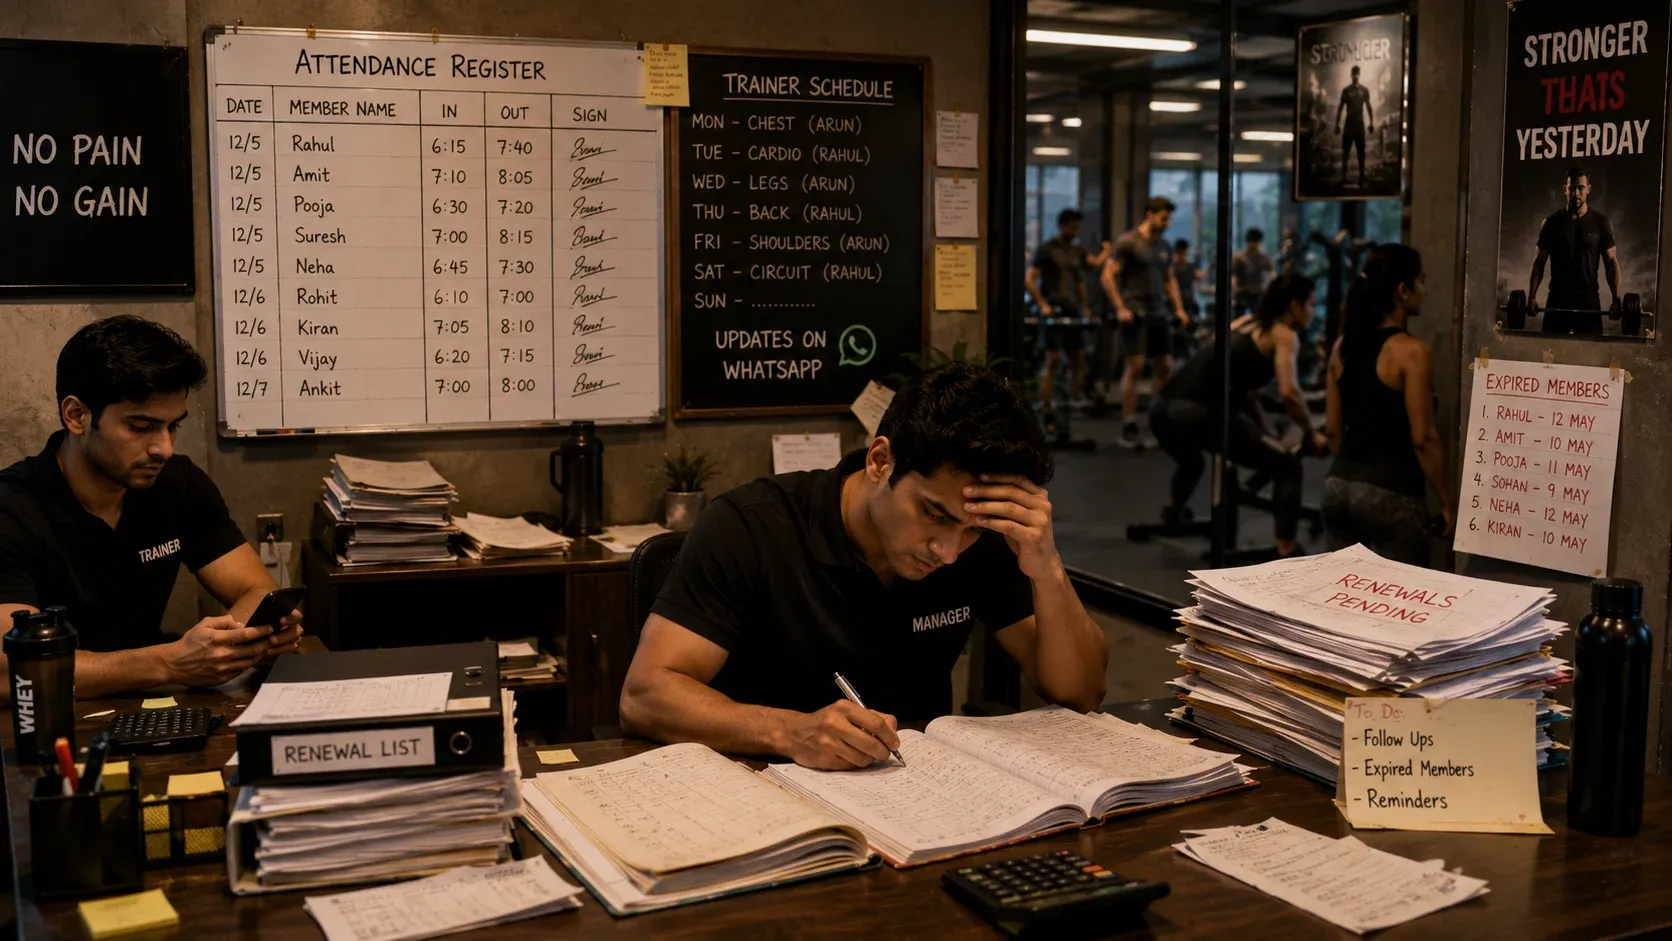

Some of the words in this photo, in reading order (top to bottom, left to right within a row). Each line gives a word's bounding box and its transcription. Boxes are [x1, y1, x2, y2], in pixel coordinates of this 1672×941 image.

[1524, 20, 1648, 67] STRONGER
[295, 49, 436, 76] ATTENDANCE
[451, 54, 546, 80] REGISTER
[723, 73, 800, 95] TRAINER
[810, 77, 892, 98] SCHEDULE
[227, 98, 262, 113] DATE
[290, 100, 349, 115] MEMBER
[357, 101, 396, 117] NAME
[443, 104, 457, 118] IN
[501, 106, 529, 119] OUT
[573, 107, 606, 122] SIGN
[692, 113, 724, 128] MON
[748, 115, 795, 130] CHEST
[809, 115, 861, 135] (ARUN)
[13, 133, 56, 164] NO
[73, 134, 141, 165] PAIN
[230, 133, 260, 152] 12/5
[292, 135, 334, 152] Rahul
[432, 138, 465, 153] 6:15
[497, 140, 532, 155] 7:40
[1516, 120, 1650, 160] YESTERDAY
[692, 144, 722, 159] TUE
[748, 146, 801, 161] CARDIO
[813, 145, 870, 165] (RAHUL)
[231, 163, 261, 181] 12/5
[293, 165, 330, 182] Amit
[432, 169, 466, 184] 7:10
[499, 169, 532, 184] 8:05
[693, 174, 725, 189] WED
[750, 175, 788, 190] LEGS
[802, 174, 854, 194] (ARUN)
[16, 185, 58, 216] NO
[74, 186, 148, 218] GAIN
[232, 194, 262, 214] 12/5
[294, 196, 334, 218] Pooja
[433, 199, 467, 214] 6:30
[498, 200, 533, 214] 7:20
[693, 204, 724, 219] THU
[750, 204, 789, 220] BACK
[803, 203, 861, 224] (RAHUL)
[233, 225, 262, 245] 12/5
[295, 227, 345, 243] Suresh
[432, 229, 467, 244] 7:00
[500, 229, 532, 244] 8:15
[695, 233, 720, 249] FRI
[750, 235, 830, 250] SHOULDERS
[840, 234, 889, 253] (ARUN)
[234, 256, 264, 276] 12/5
[297, 258, 335, 273] Neha
[434, 259, 467, 274] 6:45
[499, 260, 534, 274] 7:30
[695, 264, 725, 279] SAT
[750, 264, 811, 279] CIRCUIT
[824, 263, 881, 283] (RAHUL)
[235, 287, 265, 306] 12/6
[297, 288, 337, 304] Rohit
[435, 289, 468, 304] 6:10
[500, 290, 534, 304] 7:00
[695, 293, 725, 308] SUN
[236, 318, 266, 337] 12/6
[299, 319, 338, 335] Kiran
[434, 320, 468, 335] 7:05
[501, 319, 534, 334] 8:10
[716, 330, 793, 349] UPDATES
[803, 331, 826, 348] ON
[237, 349, 267, 367] 12/6
[299, 349, 337, 371] Vijay
[435, 349, 469, 364] 6:20
[501, 349, 534, 363] 7:15
[723, 359, 822, 379] WHATSAPP
[238, 379, 267, 398] 12/7
[300, 380, 341, 396] Ankit
[435, 379, 470, 394] 7:00
[502, 378, 535, 393] 8:00
[1487, 374, 1539, 392] EXPIRED
[1547, 379, 1610, 400] MEMBERS
[1483, 405, 1488, 418] 1.
[1497, 405, 1532, 422] RAHUL
[1552, 412, 1563, 426] 12
[1570, 414, 1595, 432] MAY
[1478, 428, 1488, 441] 2.
[1495, 429, 1524, 445] AMIT
[1550, 436, 1561, 450] 10
[1567, 439, 1593, 457] MAY
[1476, 451, 1486, 463] 3.
[1494, 451, 1526, 469] POOJA
[1549, 460, 1557, 474] 11
[1565, 463, 1591, 481] MAY
[1474, 473, 1483, 486] 4.
[1492, 475, 1528, 492] SOHAN
[1548, 483, 1555, 497] 9
[1563, 487, 1589, 505] MAY
[1472, 495, 1482, 508] 5.
[1490, 498, 1520, 515] NEHA
[1544, 507, 1555, 521] 12
[1563, 511, 1588, 529] MAY
[1469, 517, 1479, 530] 6.
[1488, 520, 1521, 538] KIRAN
[1543, 531, 1554, 544] 10
[1561, 535, 1587, 553] MAY
[139, 539, 180, 562] TRAINER
[1335, 573, 1457, 609] RENEWALS
[913, 606, 970, 632] MANAGER
[1325, 592, 1430, 623] PENDING
[16, 675, 34, 734] WHEY
[285, 743, 372, 763] RENEWAL
[381, 738, 421, 757] LIST
[1364, 729, 1403, 746] Follow
[1411, 731, 1433, 752] Ups
[1365, 759, 1413, 782] Expired
[1421, 760, 1474, 776] Members
[1367, 788, 1447, 809] Reminders
